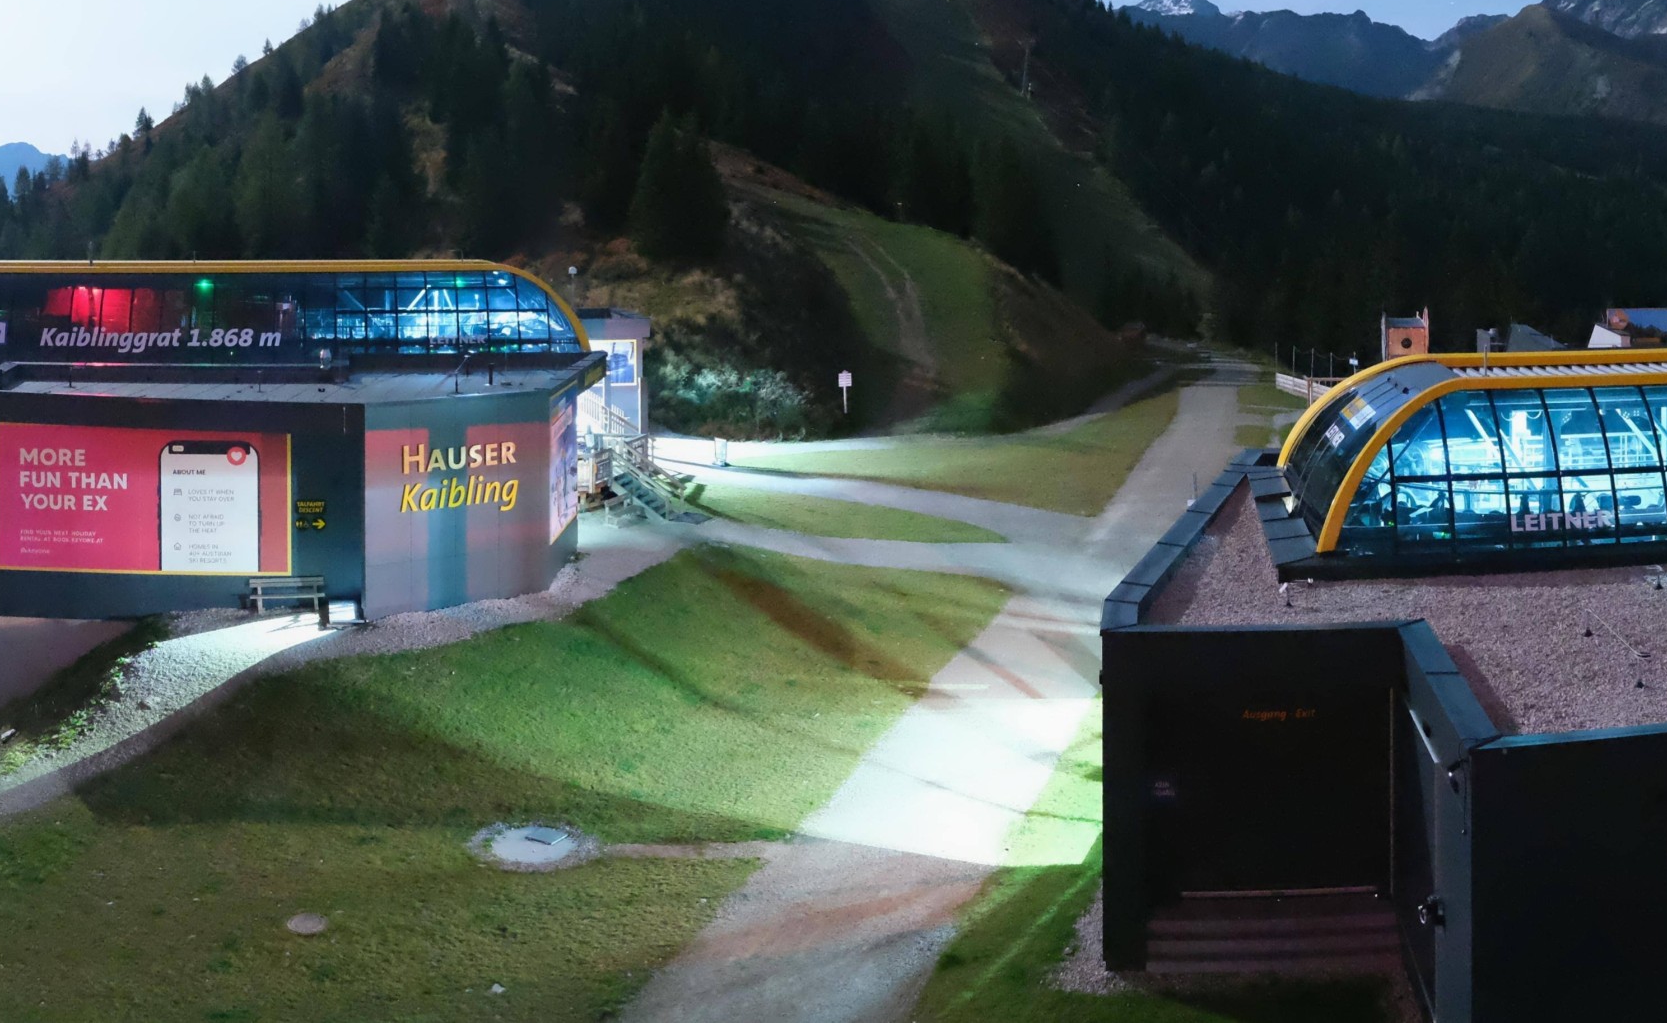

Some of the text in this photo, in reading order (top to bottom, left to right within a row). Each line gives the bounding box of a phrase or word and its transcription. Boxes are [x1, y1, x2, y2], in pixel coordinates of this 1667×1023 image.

[40, 326, 281, 353] Kaiblinggrat 1.868 m
[20, 448, 86, 466] MORE
[402, 441, 517, 475] HAUSER
[20, 471, 128, 489] FUN THAN
[21, 493, 108, 511] YOUR EX
[400, 475, 519, 513] Kaibling
[1511, 510, 1613, 532] LEITNER
[1242, 709, 1287, 721] Ausgang
[1295, 709, 1316, 719] Exit
